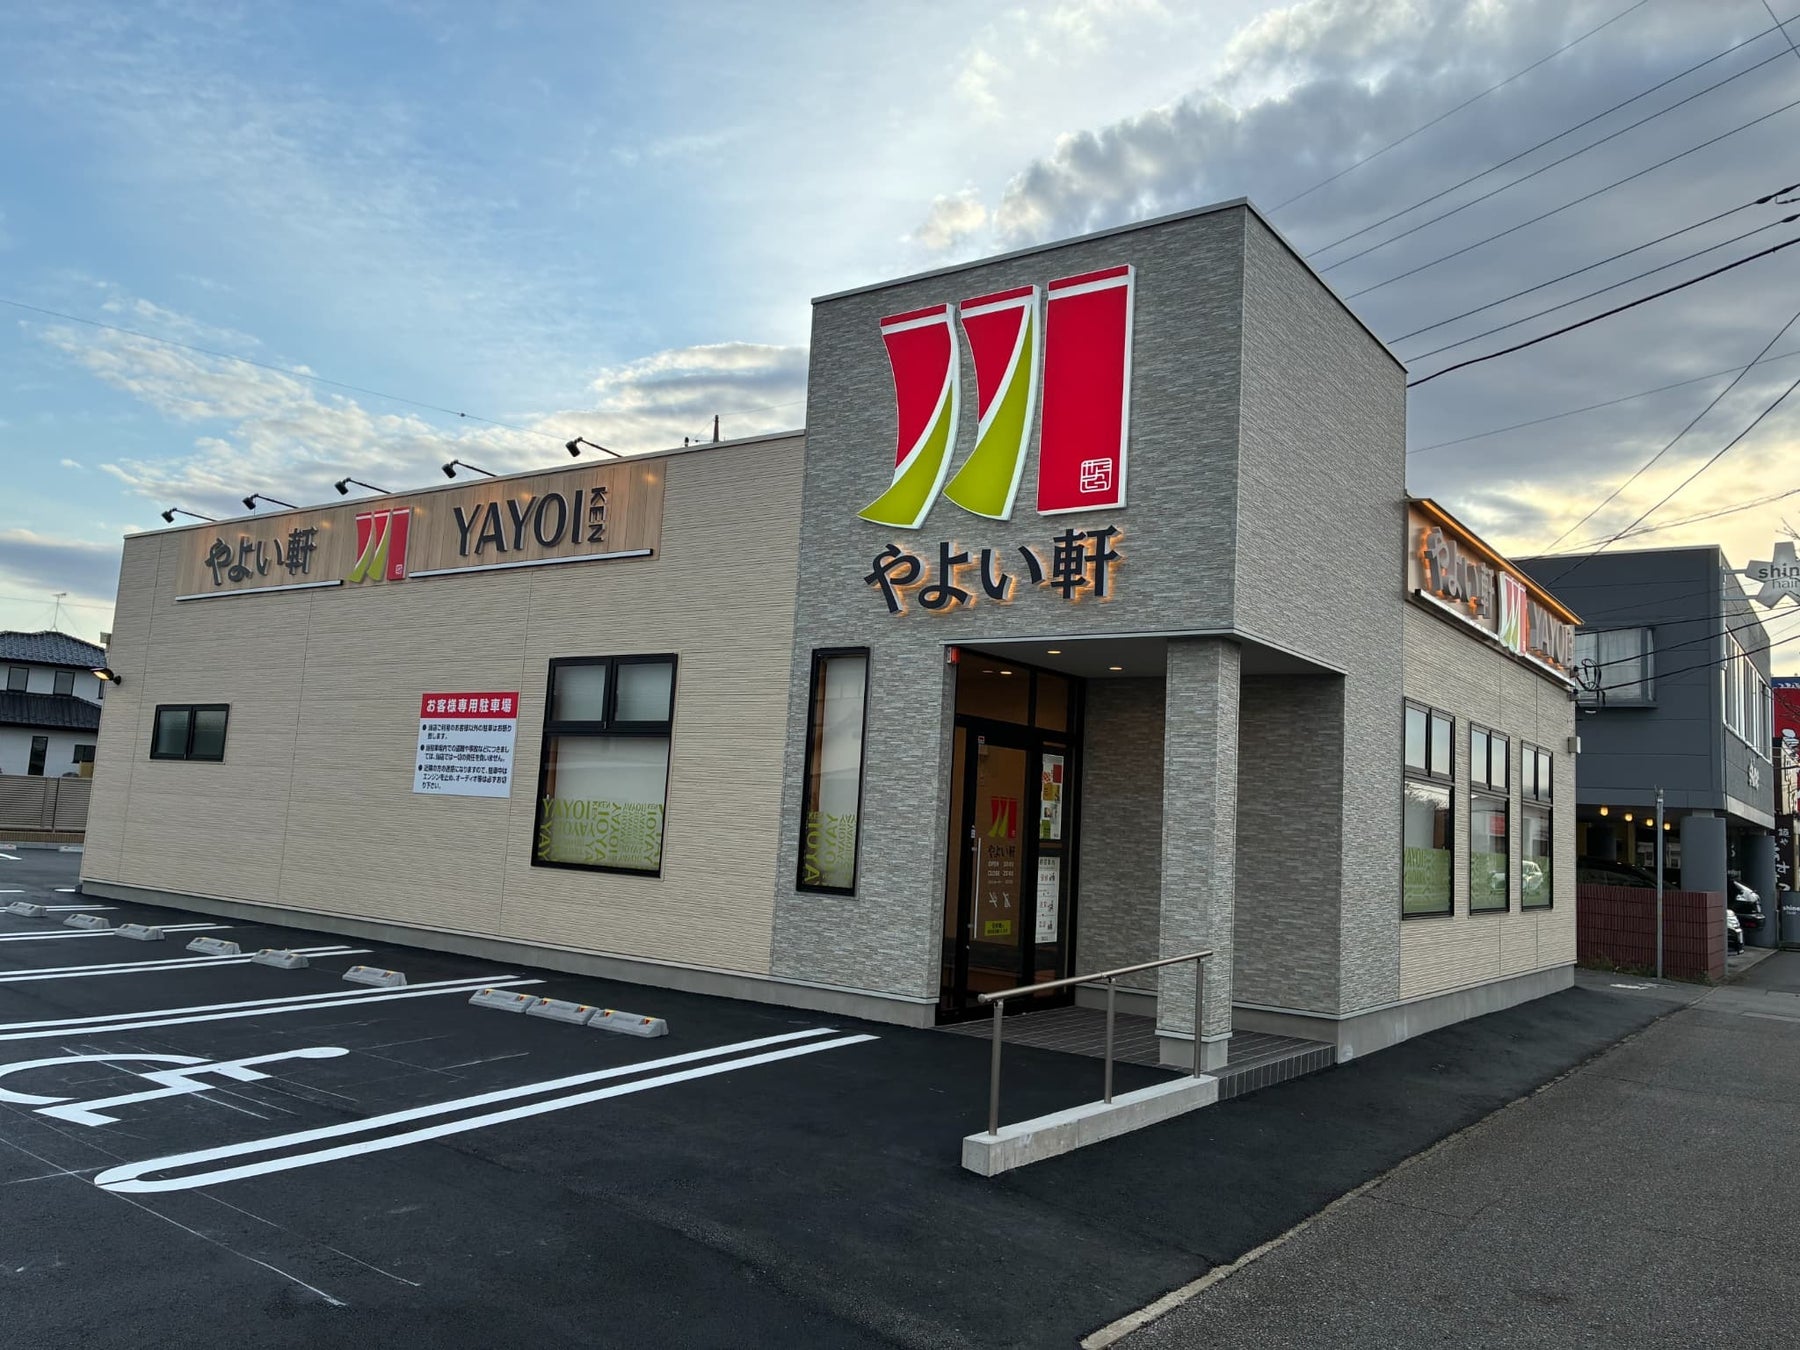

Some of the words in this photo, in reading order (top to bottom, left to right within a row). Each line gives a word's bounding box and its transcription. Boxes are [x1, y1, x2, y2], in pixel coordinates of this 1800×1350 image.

[453, 488, 583, 557] YAYOI
[588, 486, 608, 543] KEN
[204, 526, 317, 586] やよい軒
[864, 524, 1122, 614] やよい軒
[427, 698, 511, 713] お客様専用駐車場
